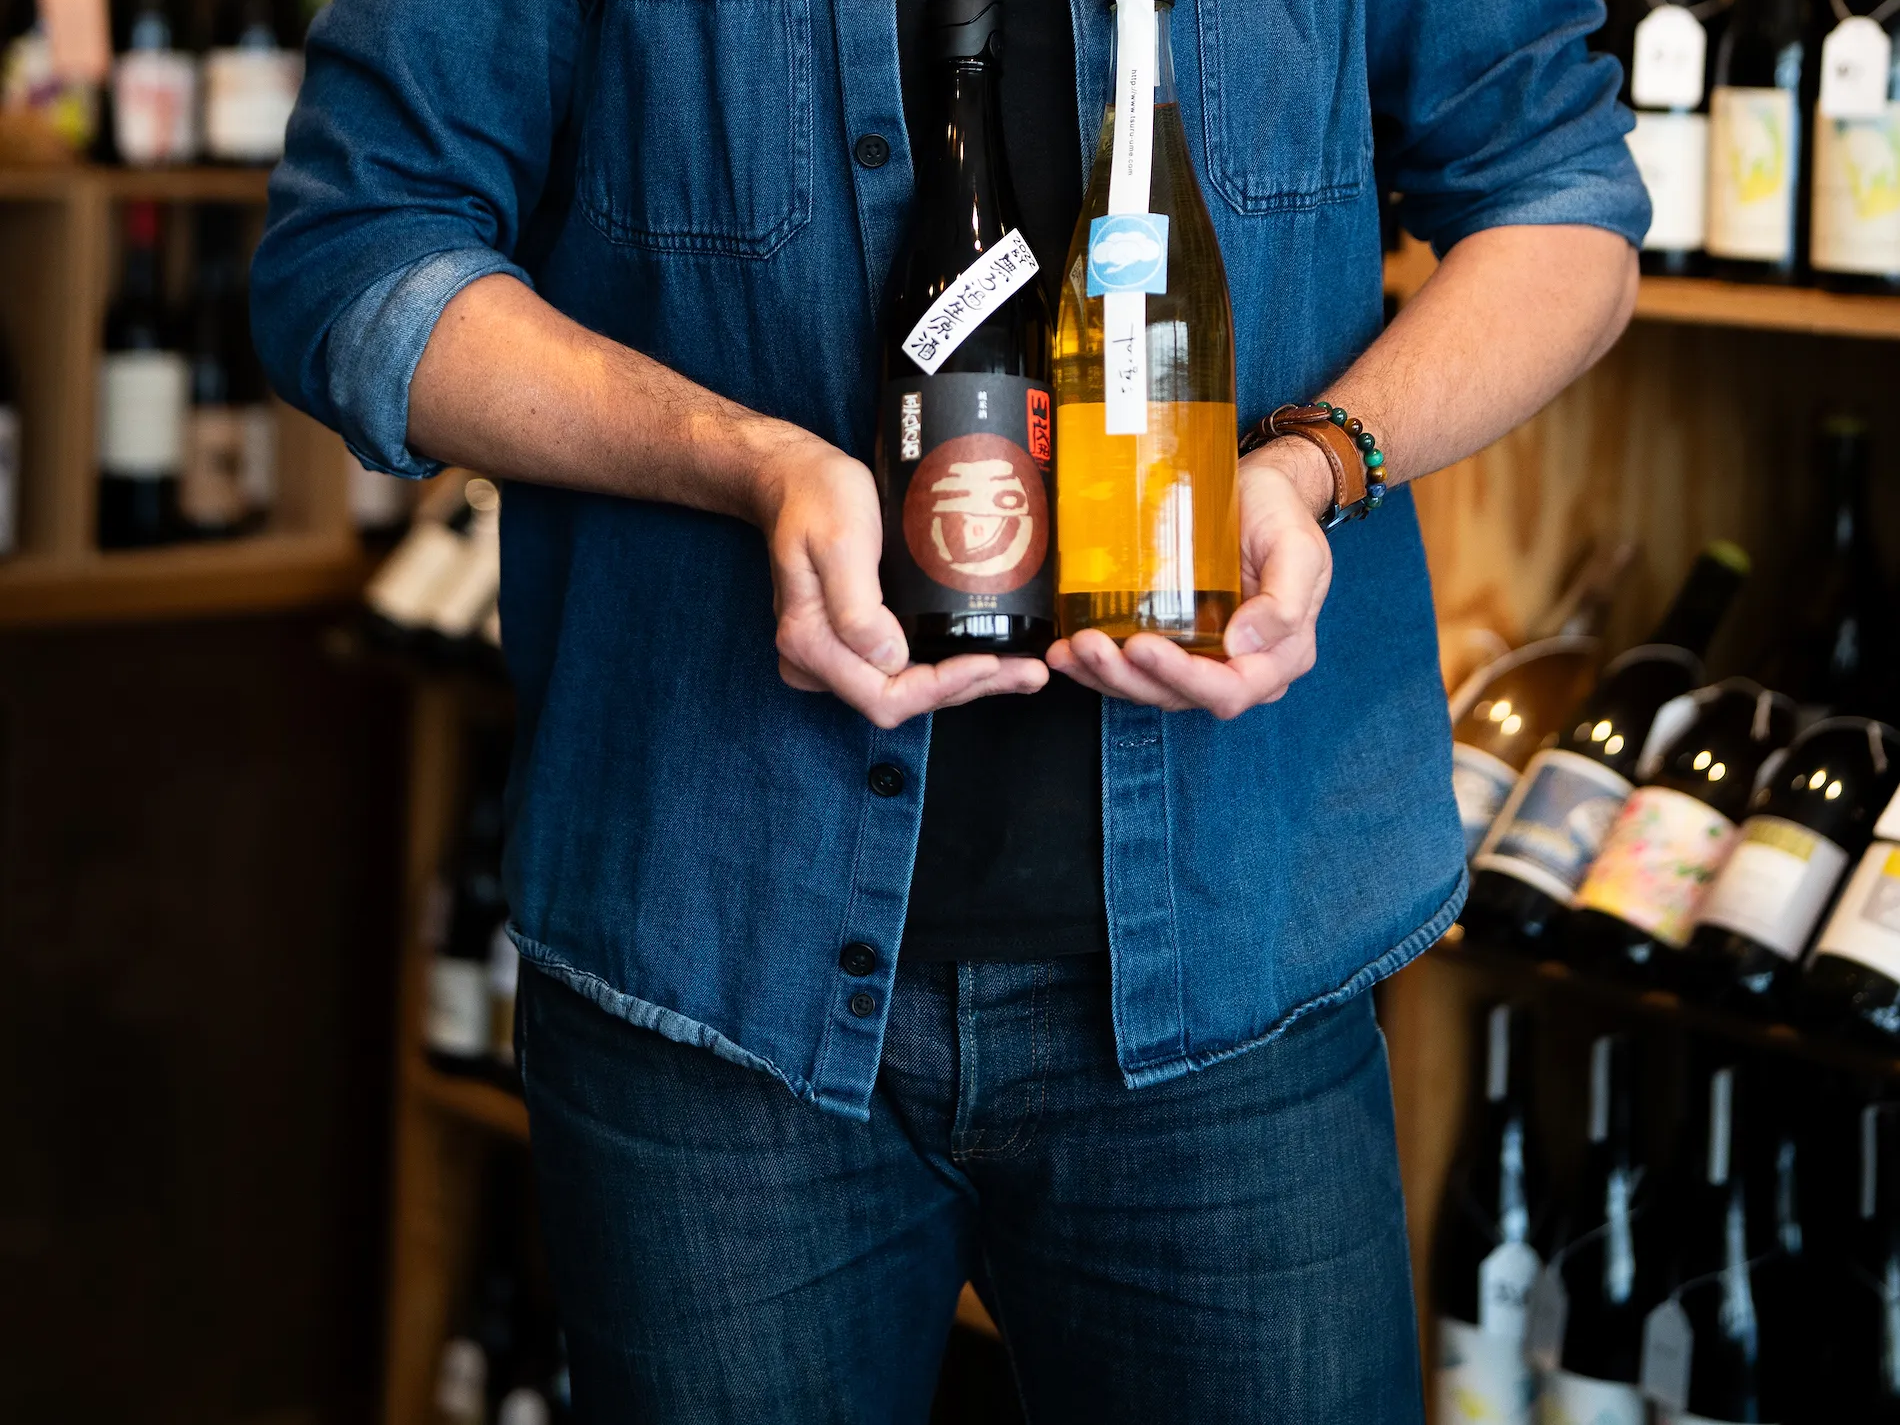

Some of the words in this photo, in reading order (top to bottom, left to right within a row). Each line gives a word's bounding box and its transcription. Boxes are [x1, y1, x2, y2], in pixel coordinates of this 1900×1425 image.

[1127, 69, 1138, 176] http://www.tsuru-ume.com
[1011, 248, 1028, 265] BY
[1012, 236, 1037, 269] 2022
